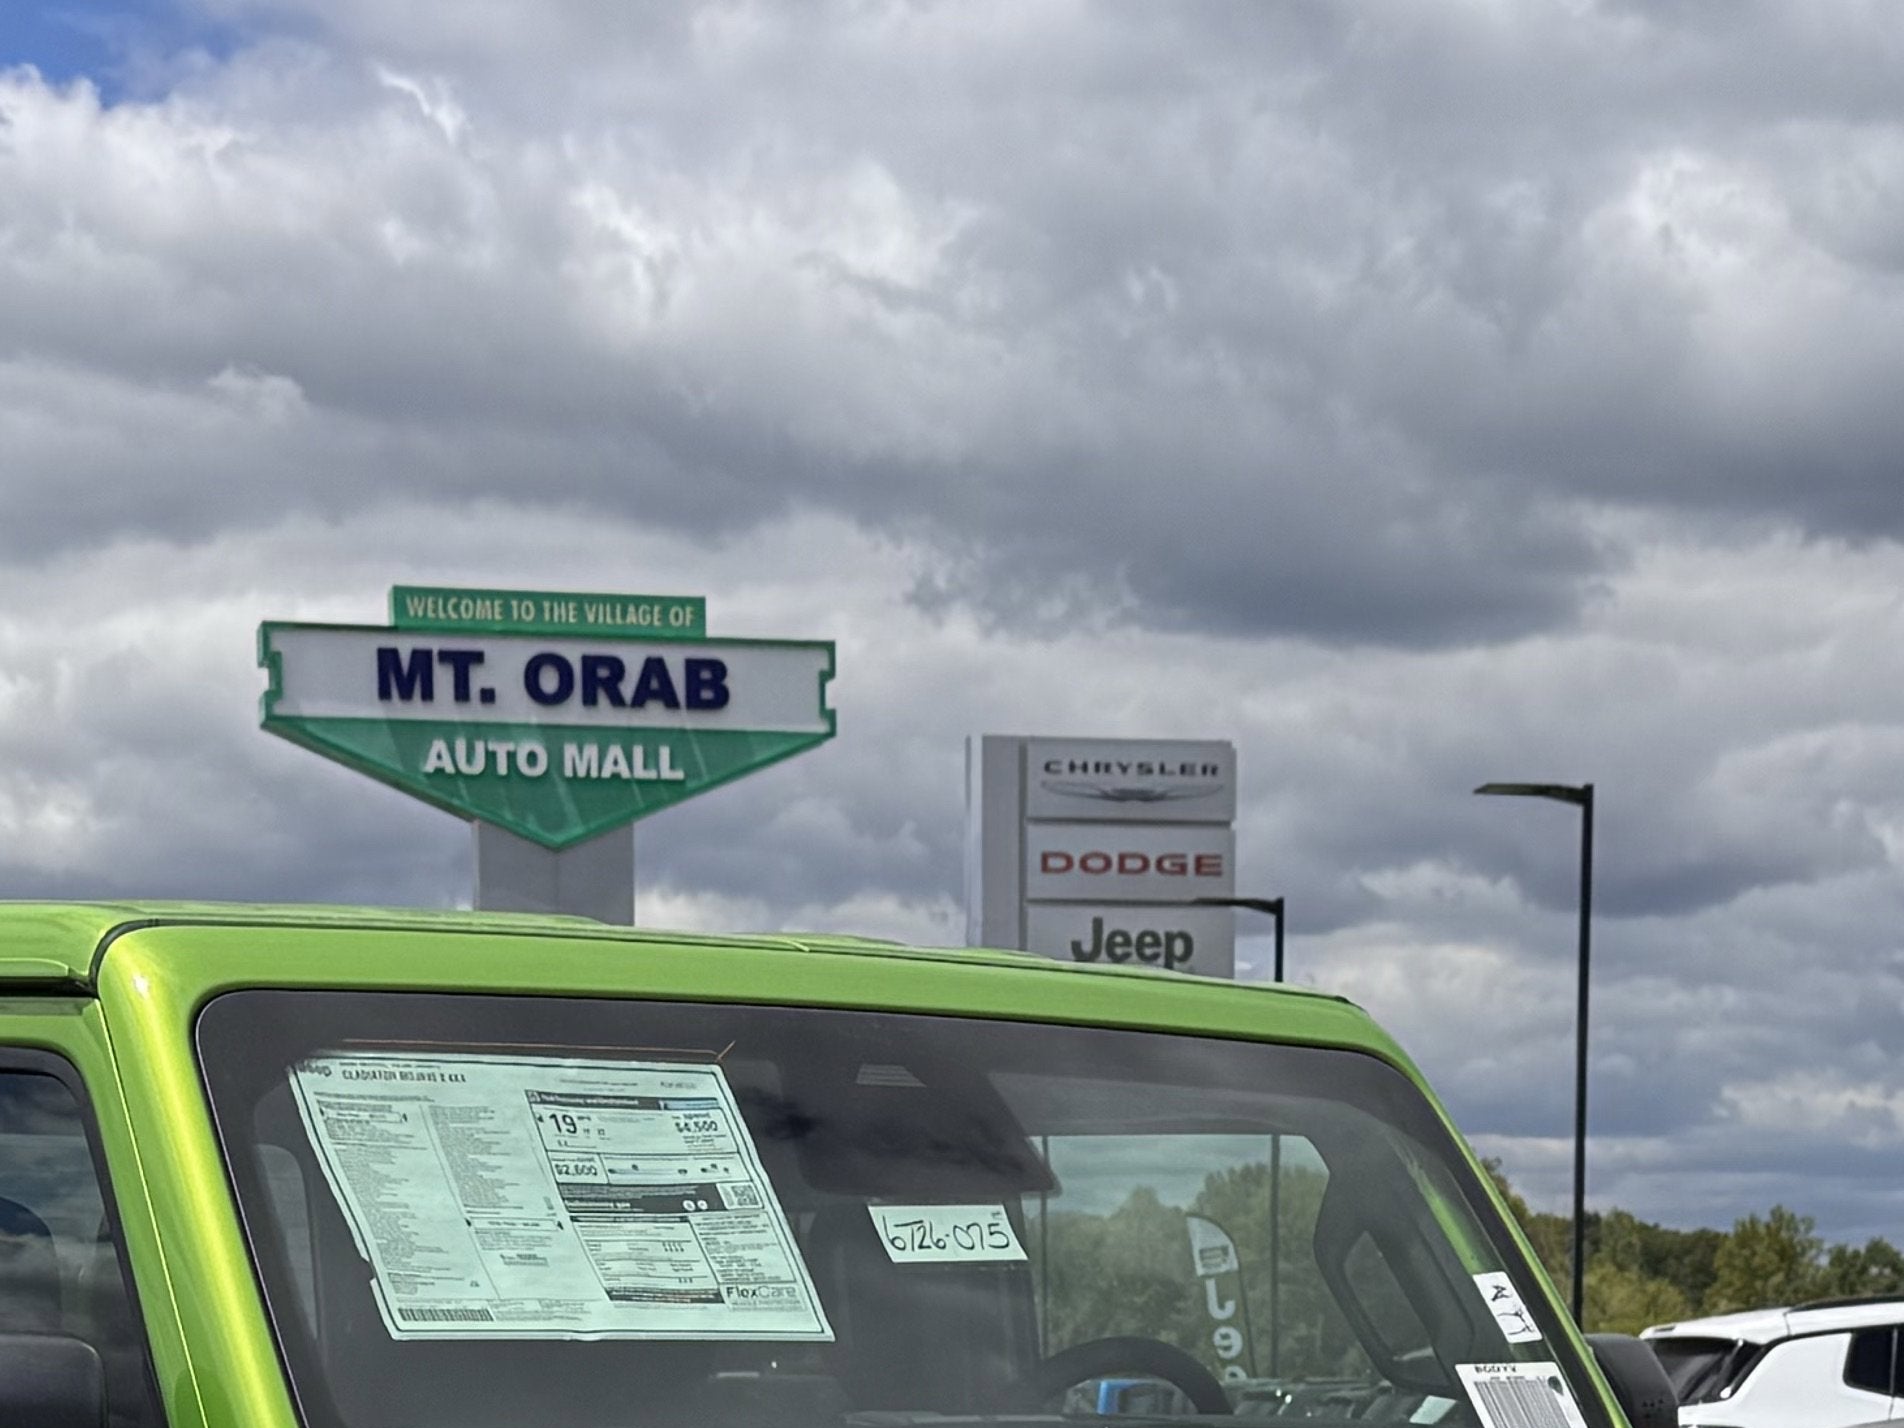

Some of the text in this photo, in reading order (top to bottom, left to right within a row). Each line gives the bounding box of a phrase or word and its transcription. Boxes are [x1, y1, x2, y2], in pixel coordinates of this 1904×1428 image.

[405, 595, 696, 627] WELCOME TO THE VILLAGE OF
[377, 647, 731, 711] MT. ORAB
[423, 738, 684, 780] AUTO MALL
[1044, 760, 1219, 777] CHRYSLER
[1041, 851, 1223, 877] DODGE
[1071, 915, 1195, 971] Jeep
[549, 1112, 578, 1135] 19
